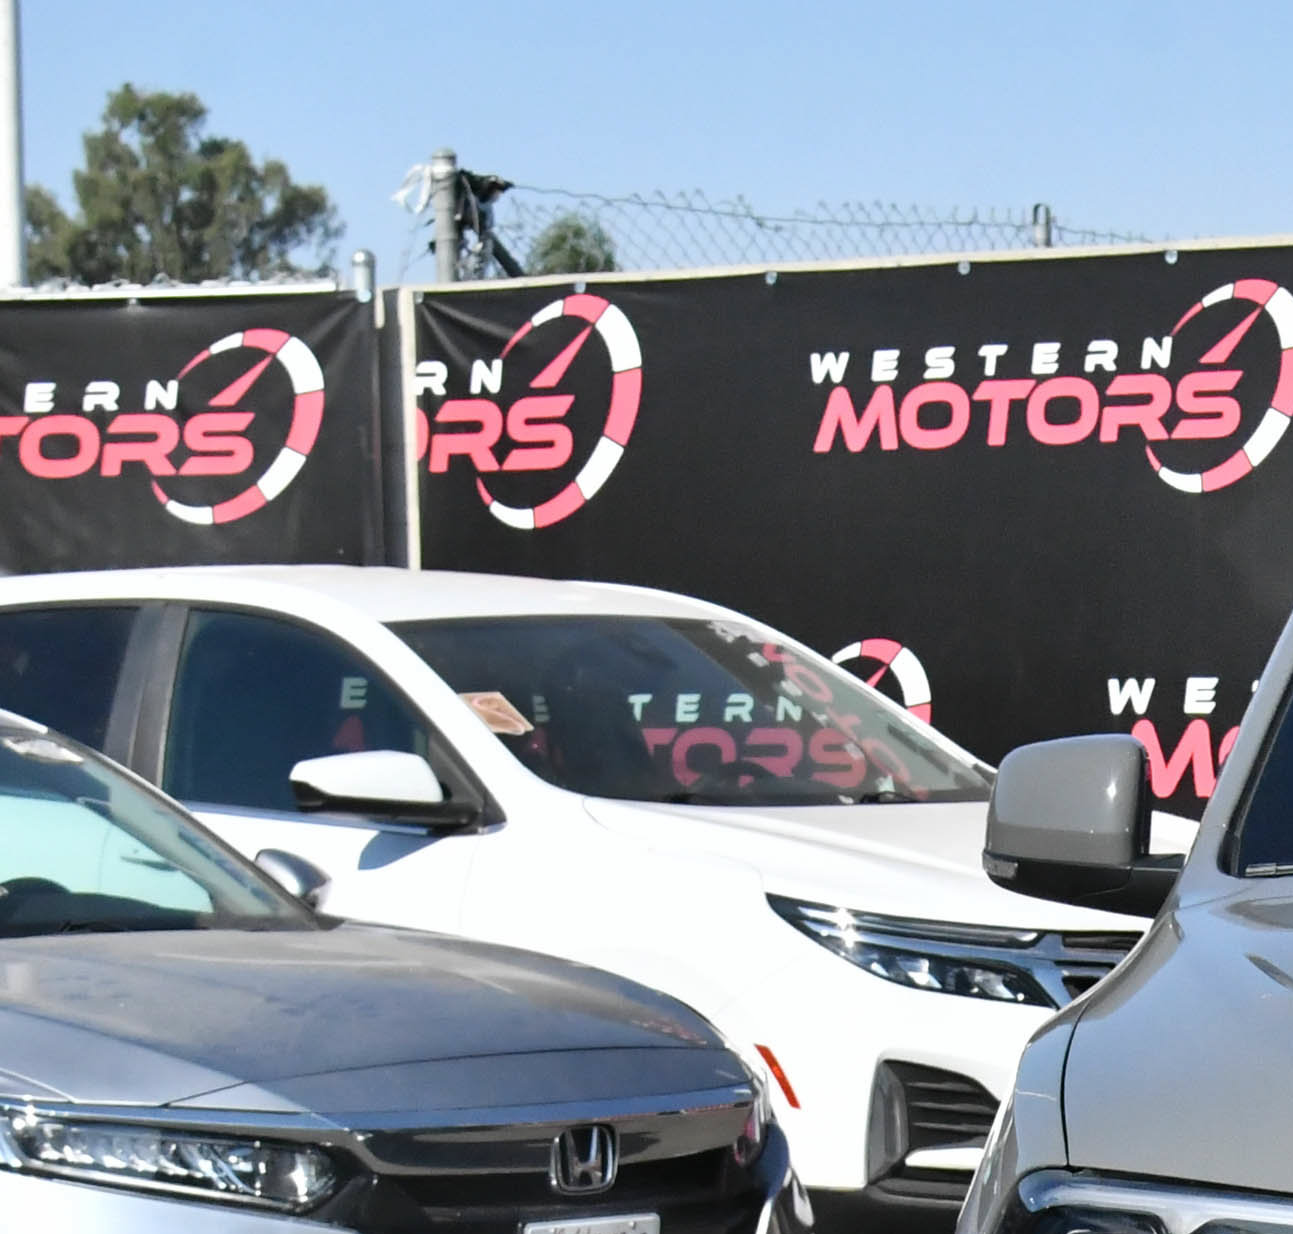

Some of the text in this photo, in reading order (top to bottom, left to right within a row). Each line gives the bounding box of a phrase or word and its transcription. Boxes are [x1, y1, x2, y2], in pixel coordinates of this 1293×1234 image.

[809, 335, 1173, 384] WESTERN
[416, 395, 576, 474] RS
[812, 369, 1244, 454] MOTORS
